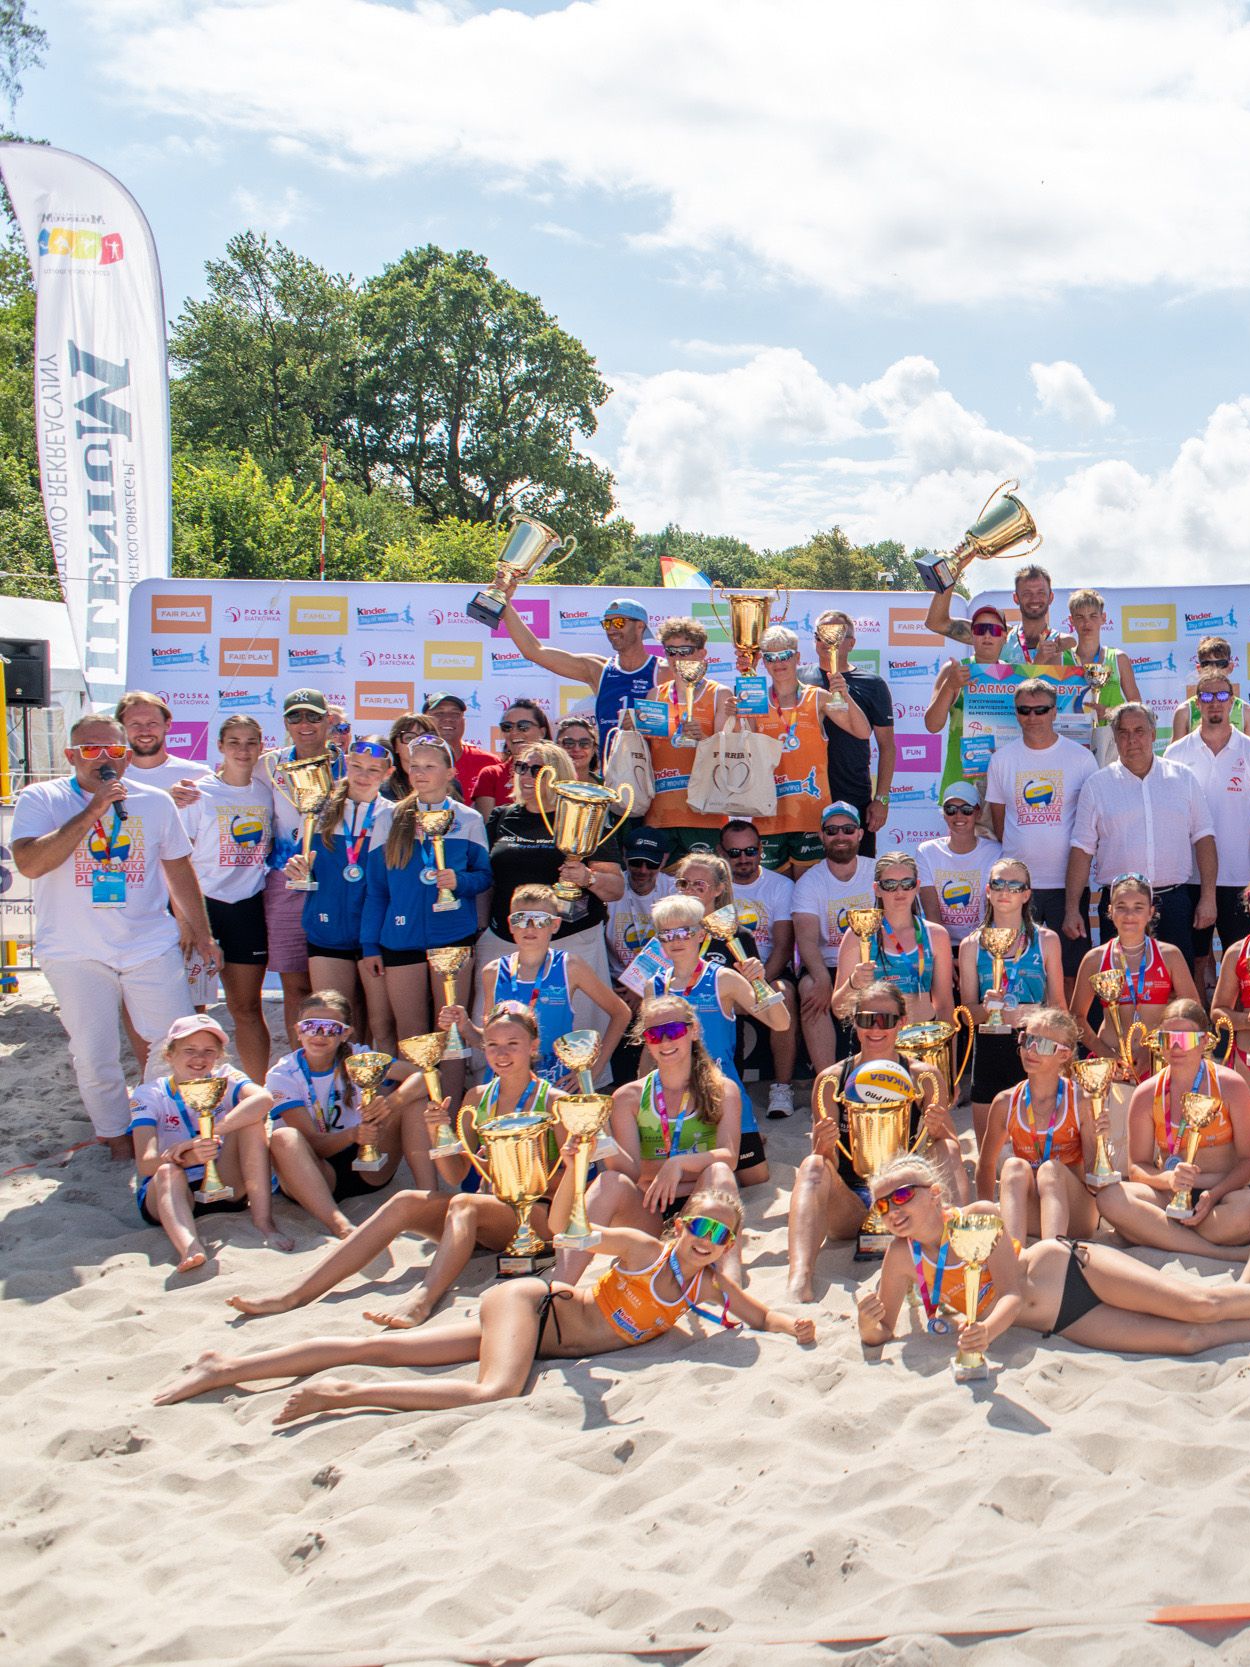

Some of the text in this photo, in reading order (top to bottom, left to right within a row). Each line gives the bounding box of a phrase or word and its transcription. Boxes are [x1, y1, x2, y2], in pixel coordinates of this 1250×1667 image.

[180, 610, 203, 618] PLAY
[1185, 611, 1212, 621] Kinder
[247, 653, 270, 661] PLAY
[889, 660, 917, 669] Kinder
[968, 684, 1083, 695] DARMO OBYT
[382, 697, 405, 705] PLAY
[619, 696, 628, 709] 1
[169, 736, 186, 744] FUN
[318, 913, 329, 923] 16
[395, 915, 406, 926] 20
[1032, 953, 1041, 966] 2
[1156, 965, 1164, 978] 1
[869, 1073, 911, 1093] MIKASA
[865, 1091, 882, 1101] PRO
[330, 1104, 345, 1130] 2
[1218, 1111, 1226, 1125] 2
[1068, 1127, 1076, 1138] 1
